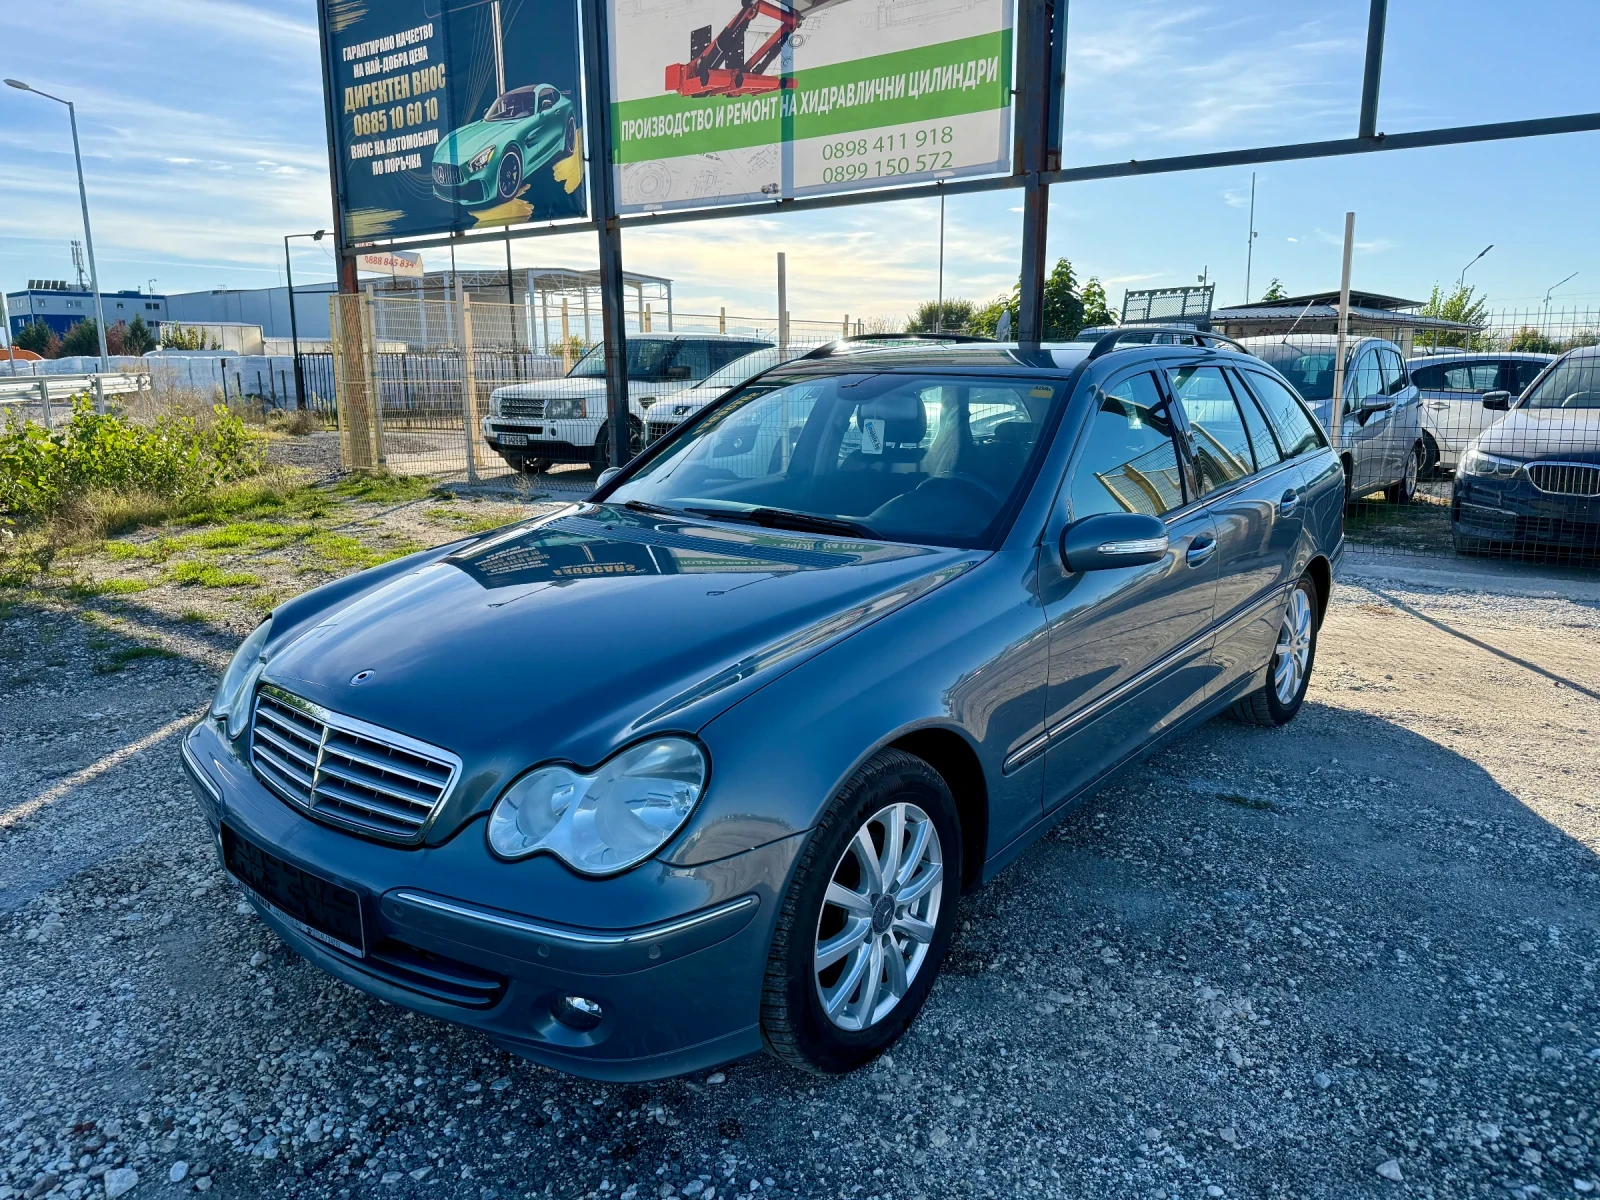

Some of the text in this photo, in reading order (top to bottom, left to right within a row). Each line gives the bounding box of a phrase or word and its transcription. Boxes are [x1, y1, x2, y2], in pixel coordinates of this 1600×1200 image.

[343, 23, 433, 61] ГАРАНТИРАНО КАЧЕСТВО
[353, 46, 428, 78] НА НАЙ-ДОБРА ЦЕНА
[344, 63, 446, 114] ДИРЕКТЕН ВНОС
[621, 56, 998, 141] ПРОИЗВОДСТВО И РЕМОНТ НА ХИДРАВЛИЧНИ ЦИЛИНДРИ
[353, 97, 439, 136] 0885 10 60 10
[350, 128, 439, 159] ВНОС НА АВТОМОБИЛИ
[822, 126, 953, 160] 0898 411 918
[372, 153, 421, 176] ПО ПОРЪЧКА
[822, 150, 953, 184] 0899 150 572
[364, 255, 415, 269] 0888 845 834
